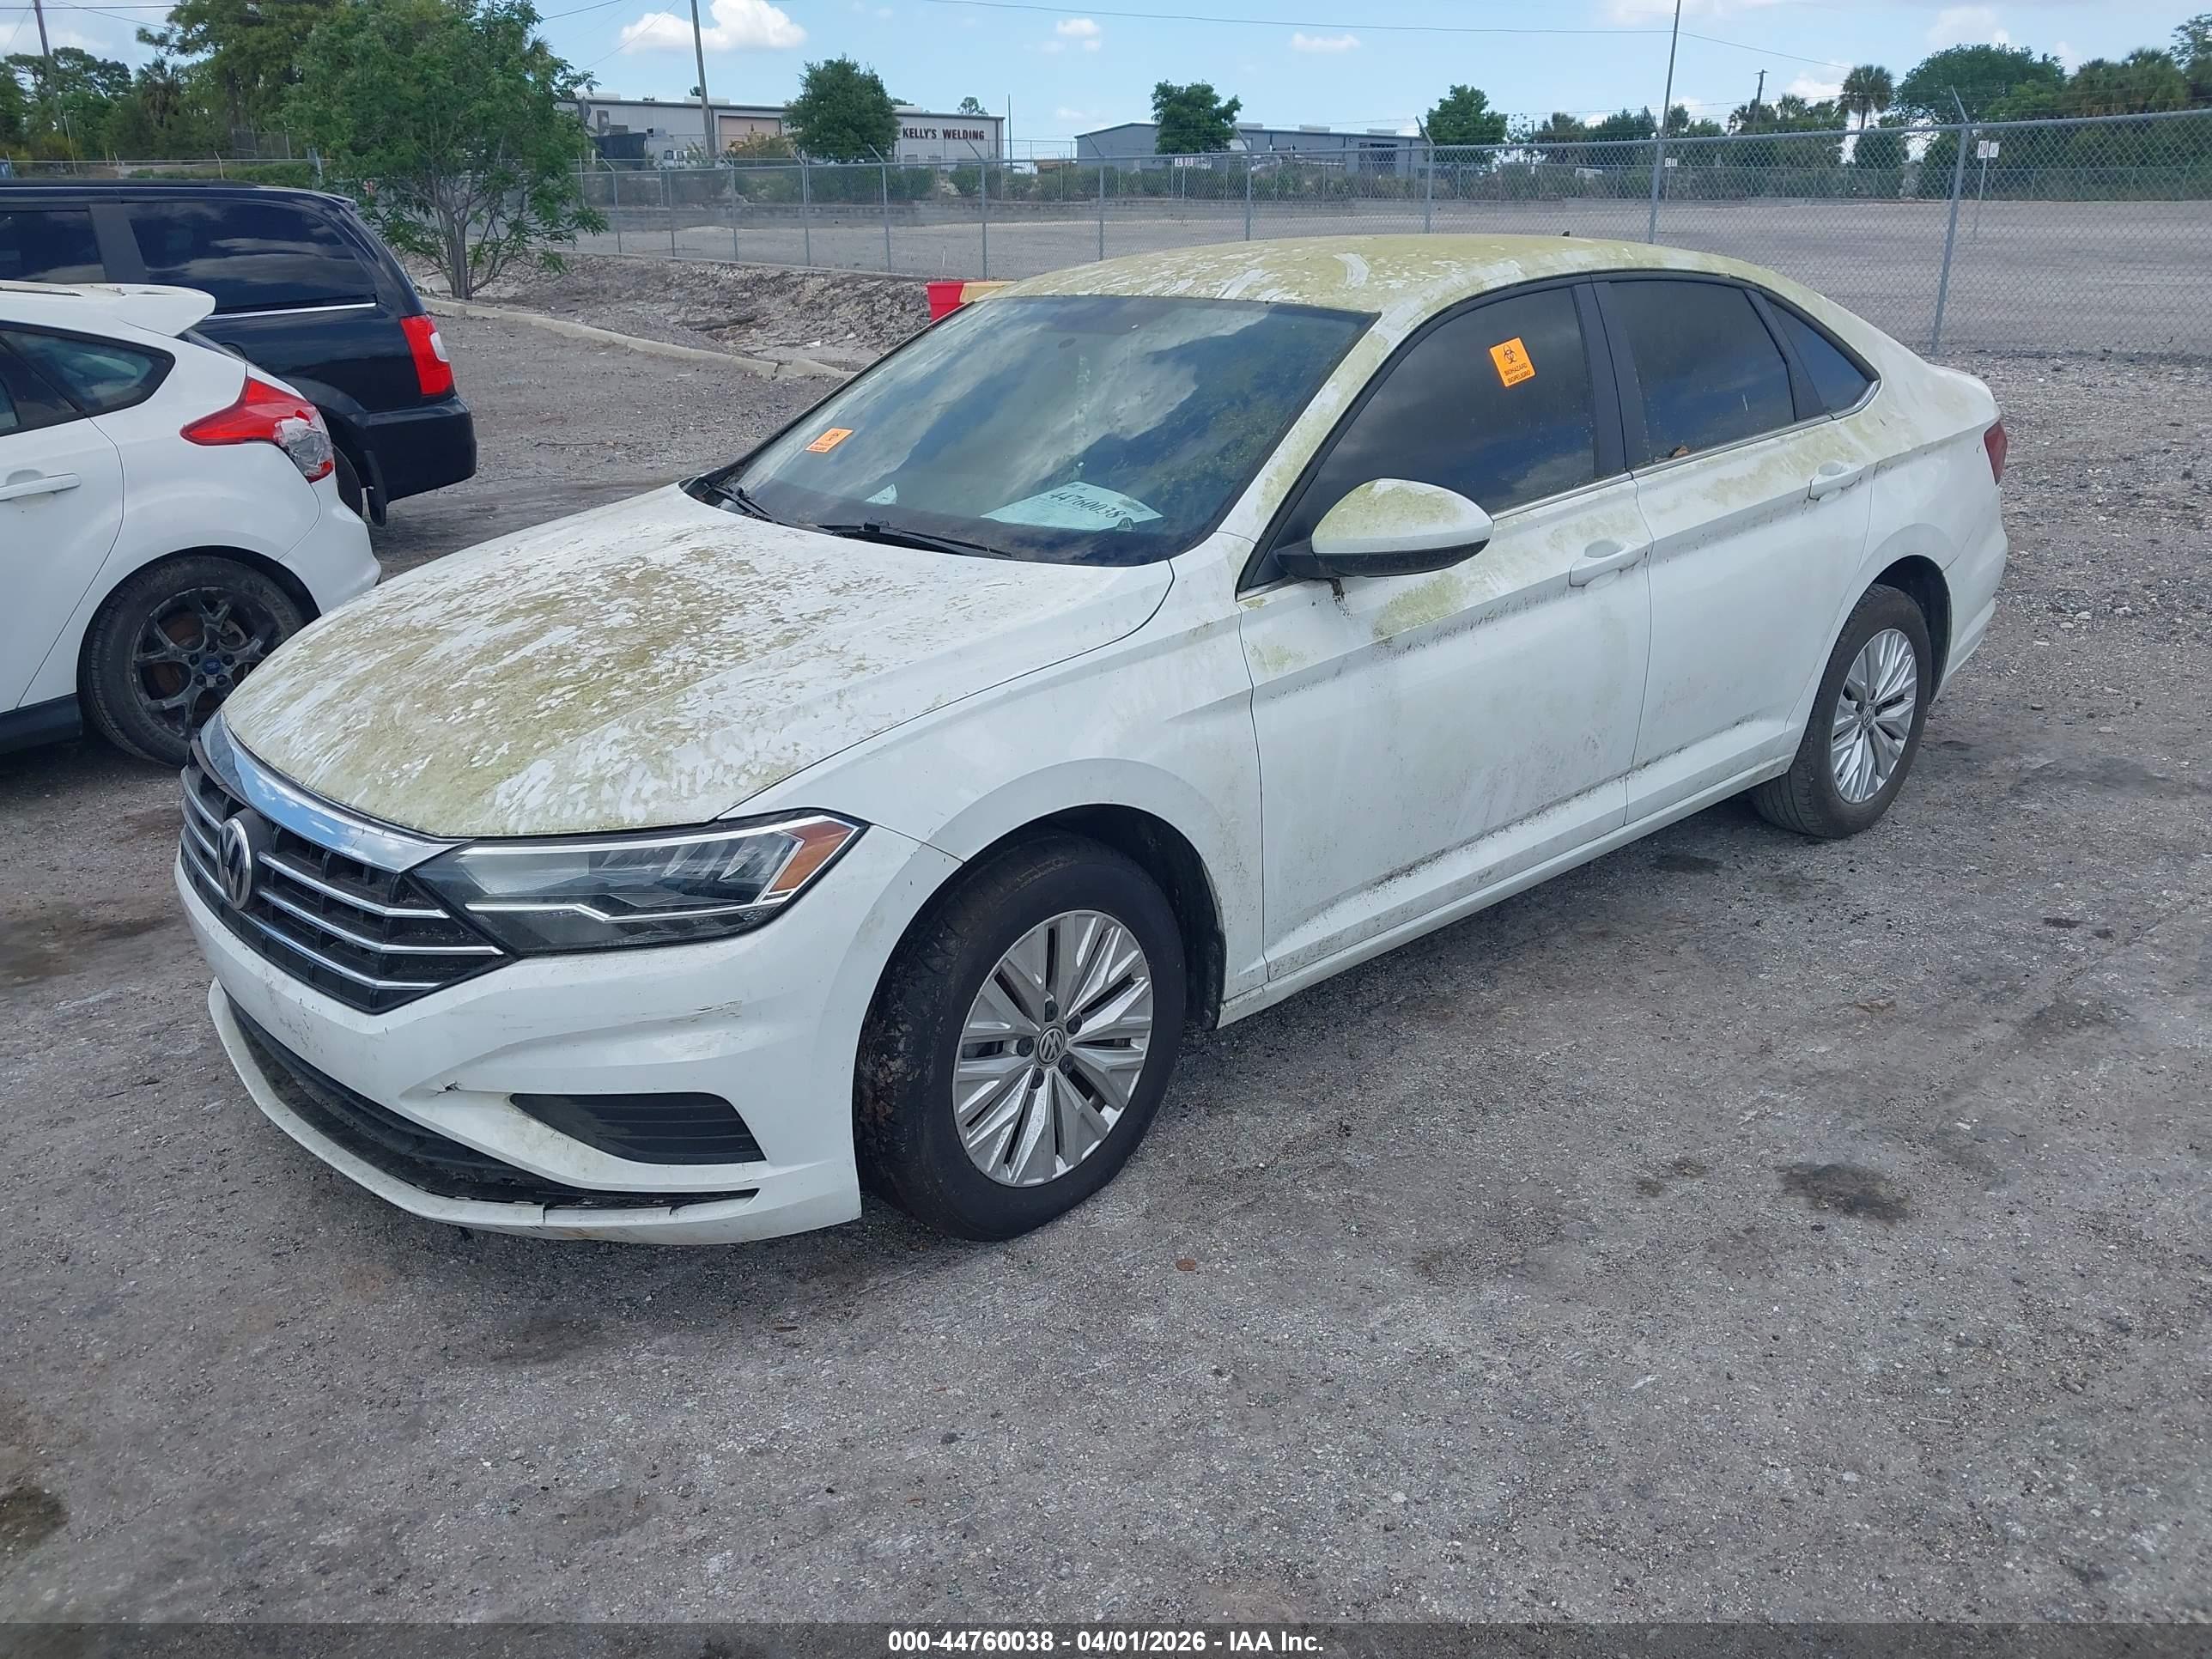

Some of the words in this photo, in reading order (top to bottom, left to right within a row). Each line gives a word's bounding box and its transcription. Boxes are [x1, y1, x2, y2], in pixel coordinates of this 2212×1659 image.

[902, 127, 937, 138] KELLY'S
[942, 128, 985, 140] WELDING
[1049, 492, 1126, 519] 44760038
